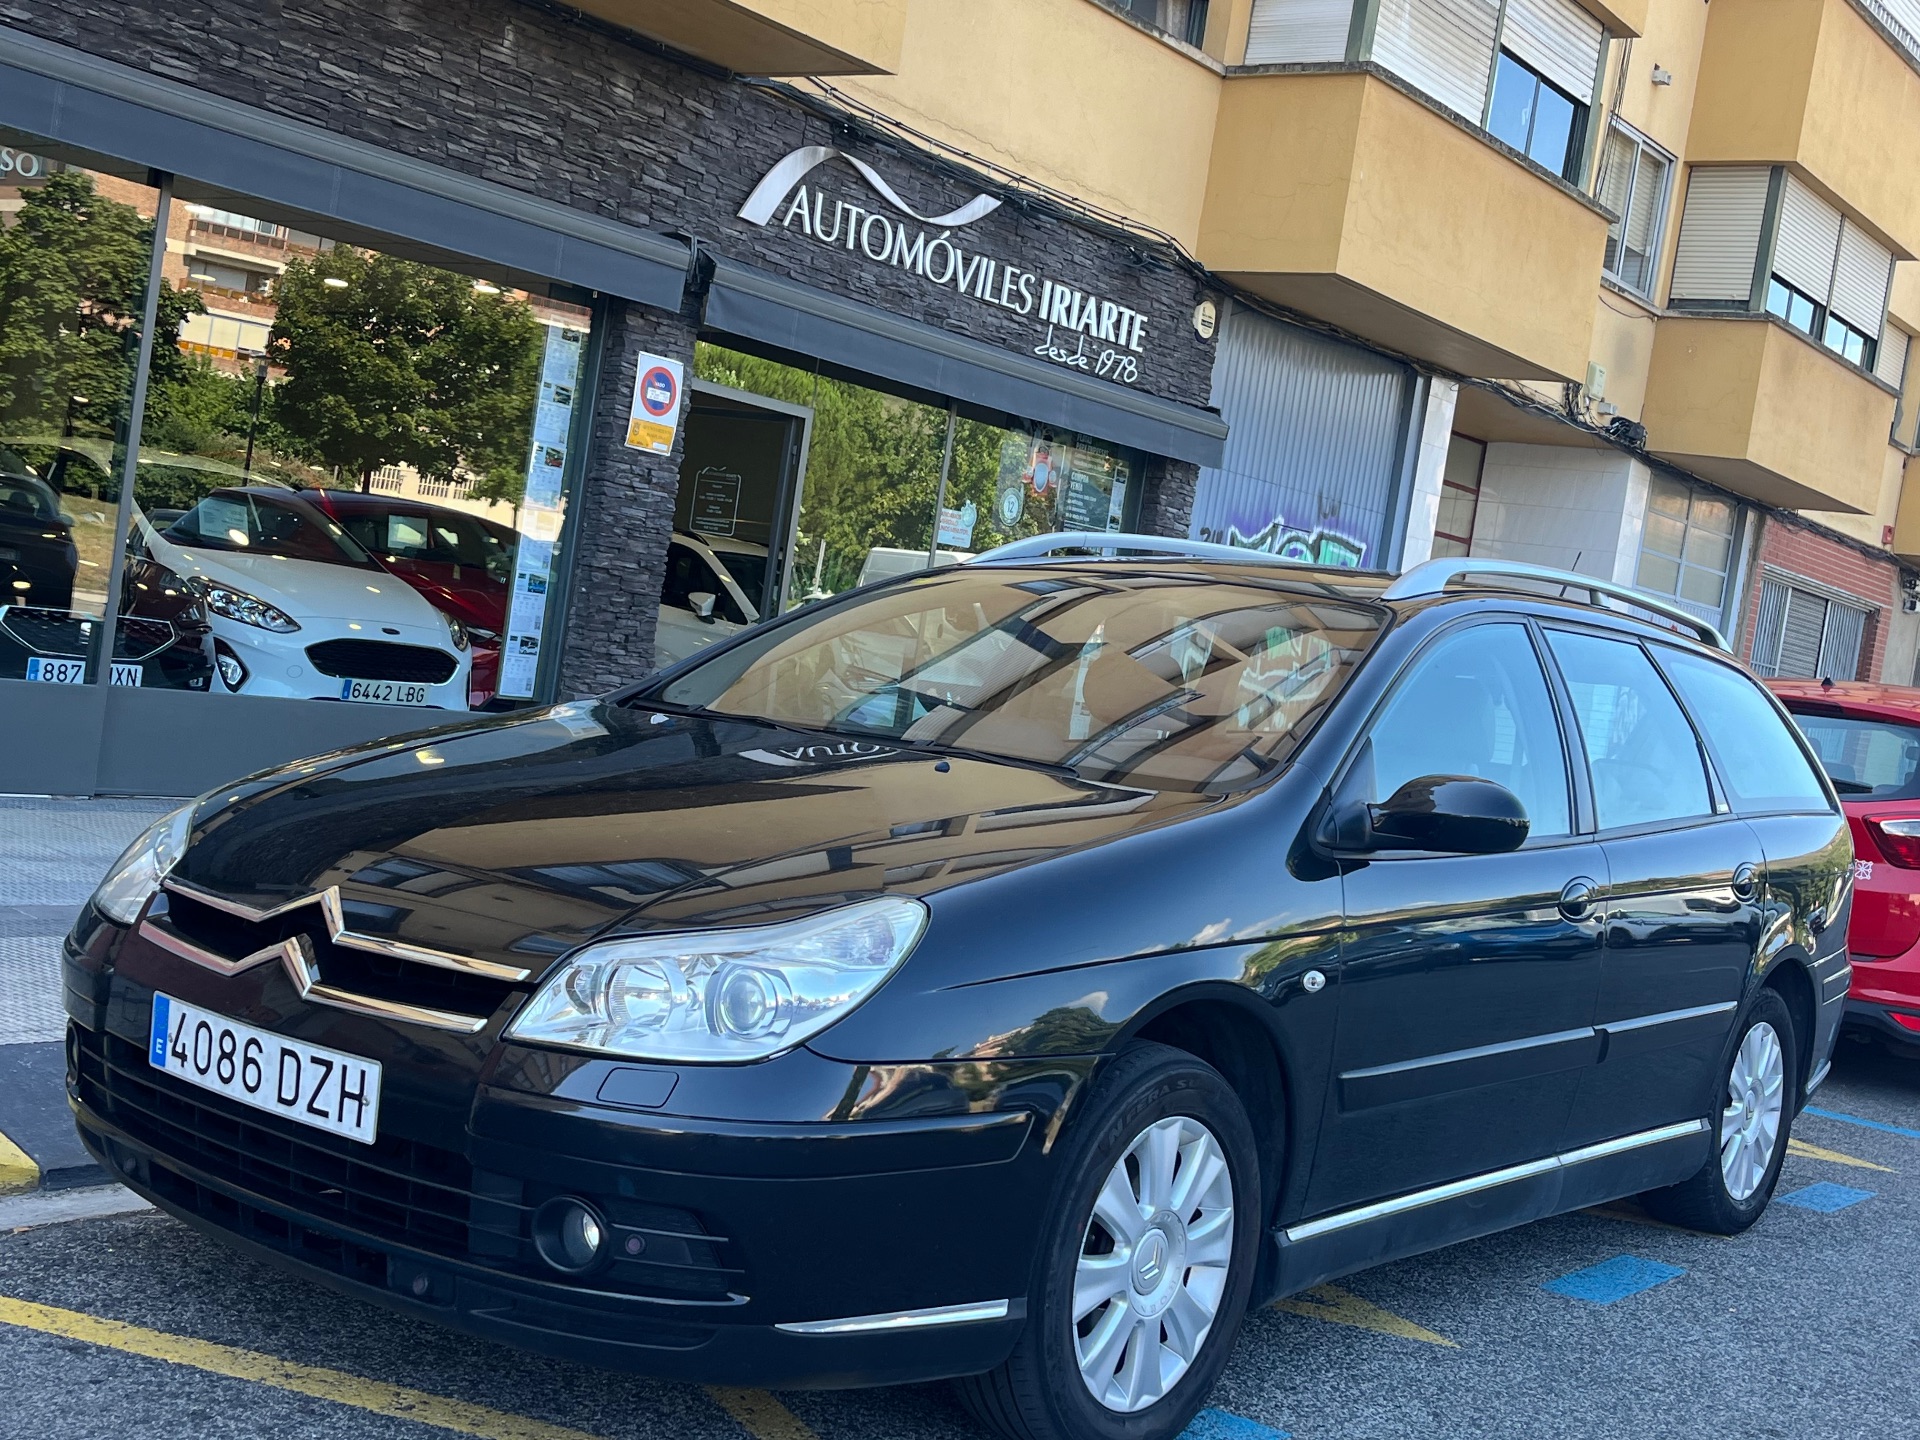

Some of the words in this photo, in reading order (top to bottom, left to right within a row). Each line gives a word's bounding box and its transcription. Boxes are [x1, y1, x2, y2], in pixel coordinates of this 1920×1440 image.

[782, 184, 1036, 315] AUTOMÓVILES
[1037, 280, 1149, 353] IRIARTE
[1033, 323, 1090, 370] desde
[1094, 348, 1139, 383] 1978
[42, 662, 83, 684] 887
[351, 682, 393, 701] 6442
[396, 685, 425, 703] LBG
[155, 1037, 164, 1055] E
[170, 1012, 264, 1094] 4086
[276, 1046, 367, 1128] DZH
